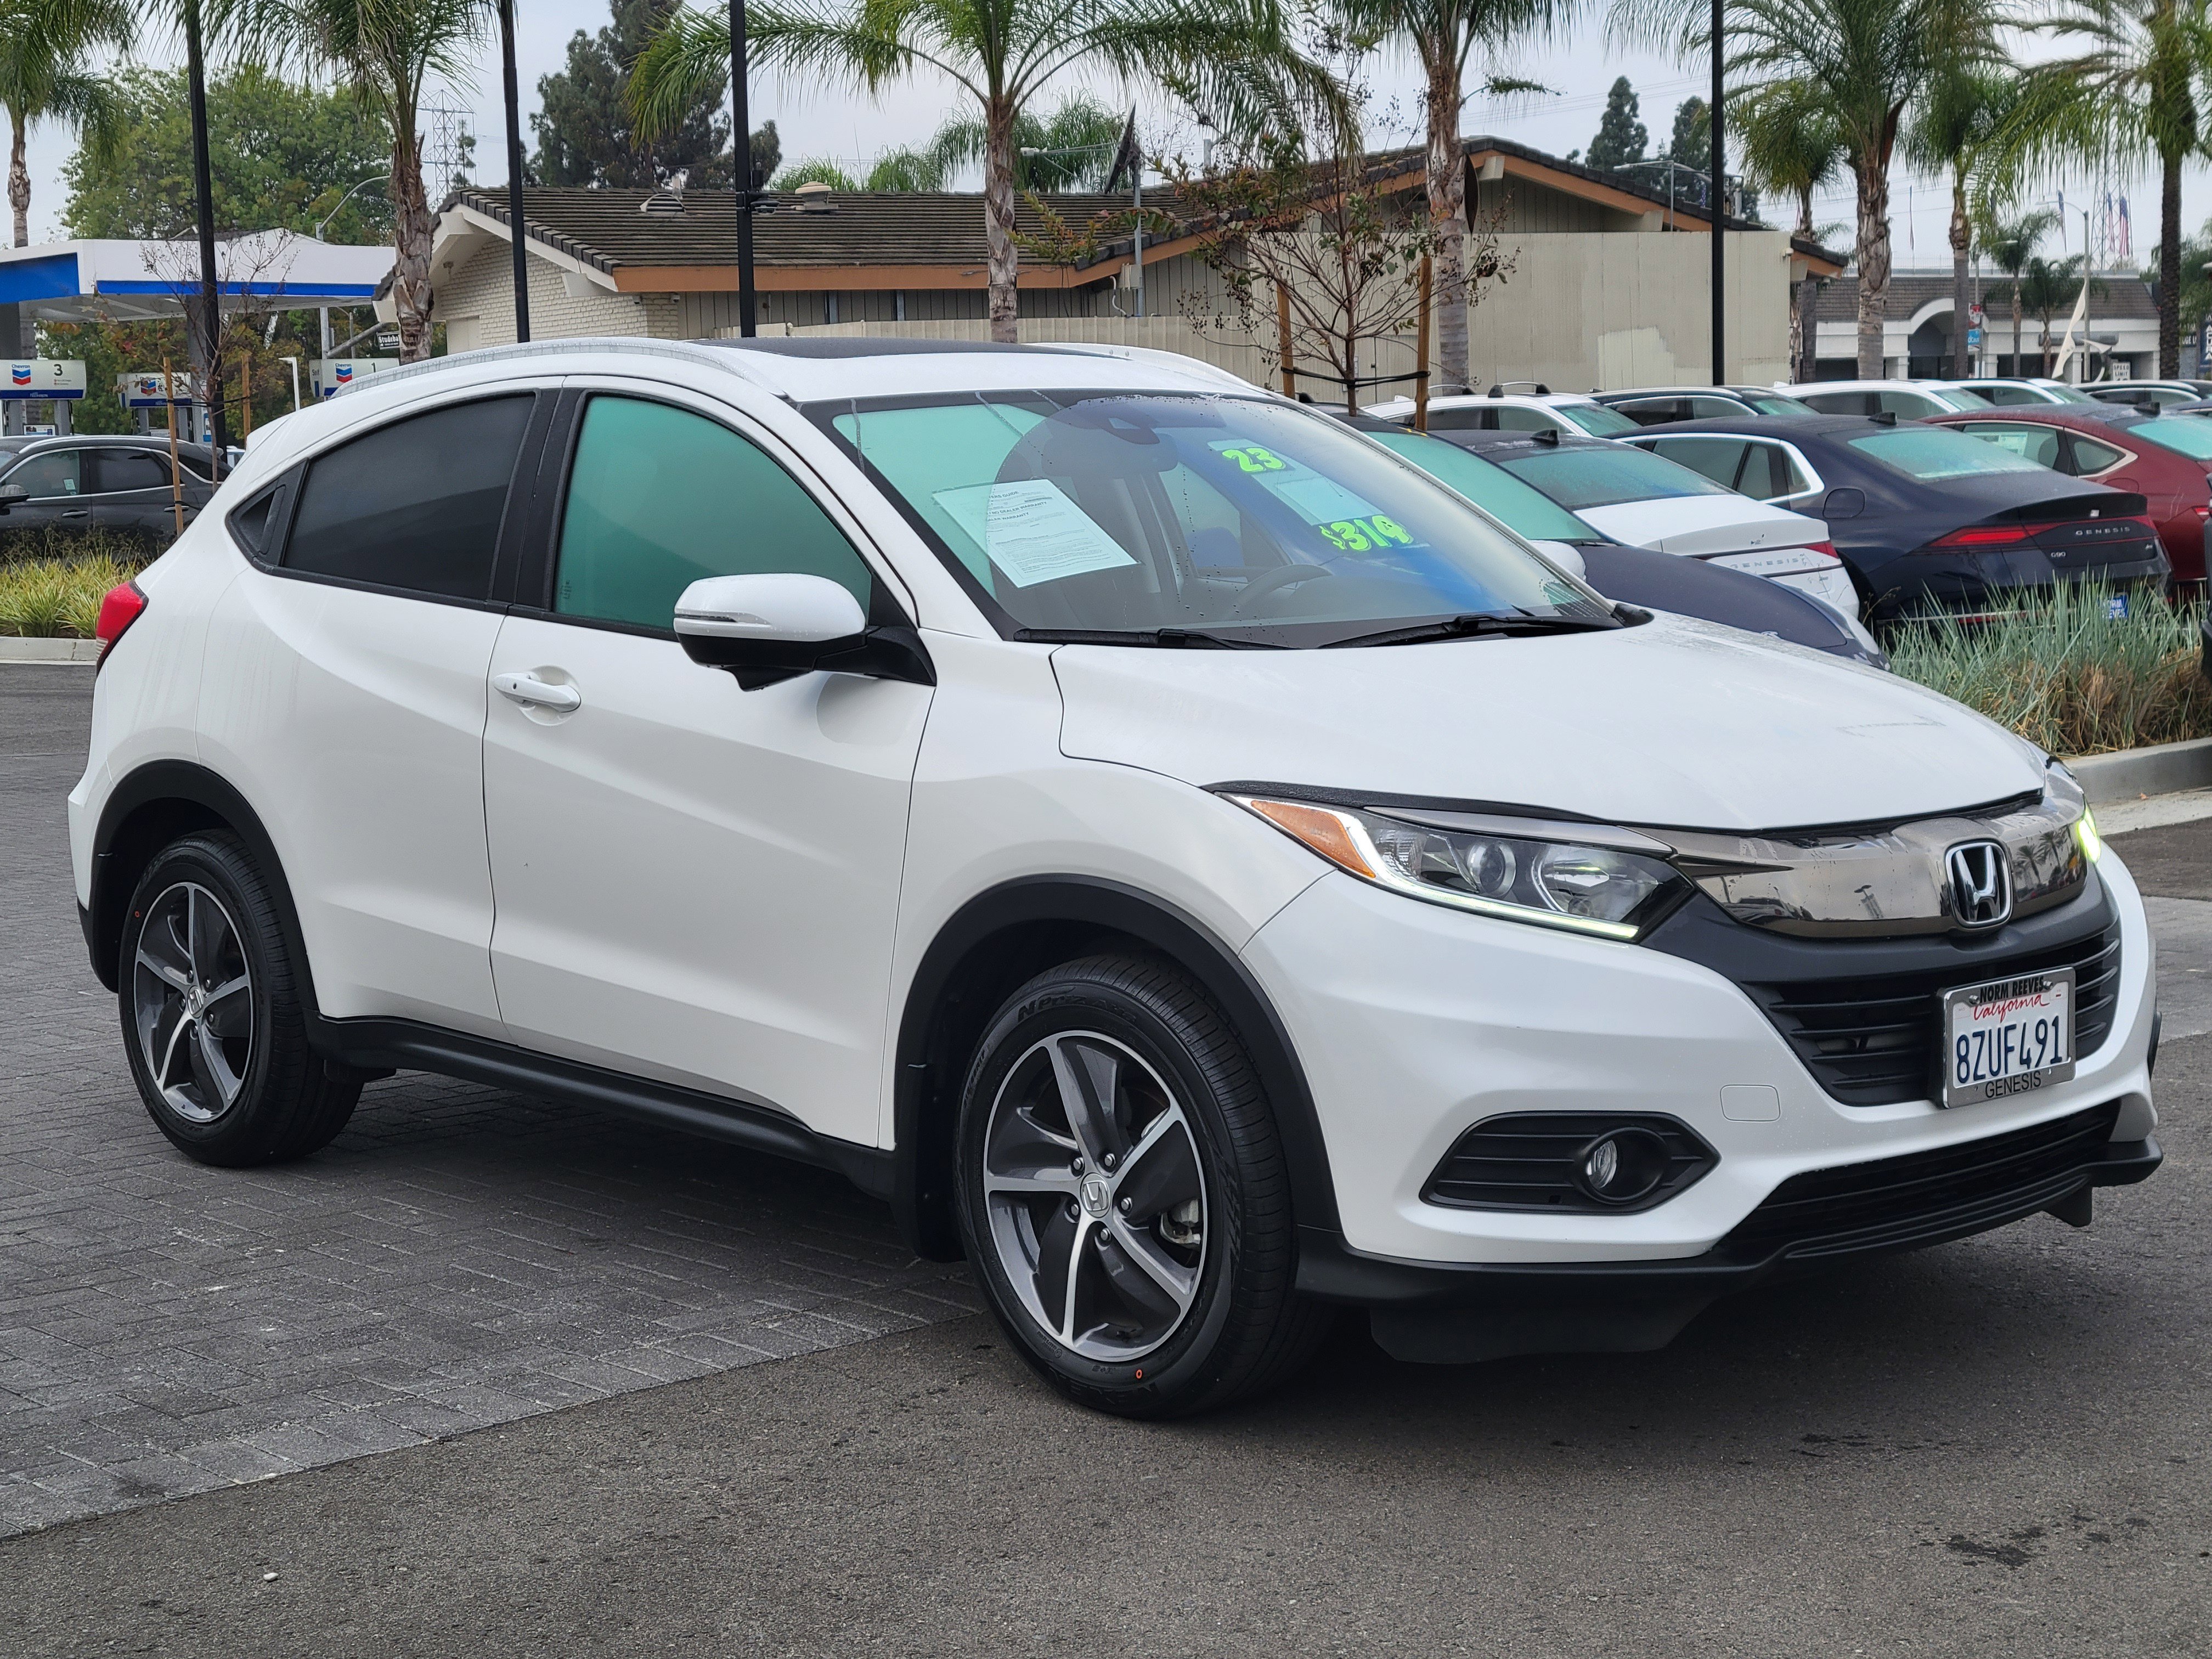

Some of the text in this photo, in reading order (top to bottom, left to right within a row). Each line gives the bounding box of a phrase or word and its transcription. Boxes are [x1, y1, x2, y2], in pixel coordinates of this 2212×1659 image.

[378, 334, 400, 343] Studeba
[54, 364, 63, 376] 3
[371, 362, 376, 373] 1
[1222, 447, 1286, 472] 23
[1020, 501, 1047, 510] WARRANTY
[1002, 512, 1030, 520] WARRANTY
[1319, 515, 1414, 551] $314
[2075, 527, 2131, 536] GENESIS
[1979, 976, 2044, 1003] NORM REEVES
[1973, 994, 2050, 1024] California
[1956, 1015, 2062, 1084] 8ZUF491
[1985, 1070, 2041, 1098] GENESIS
